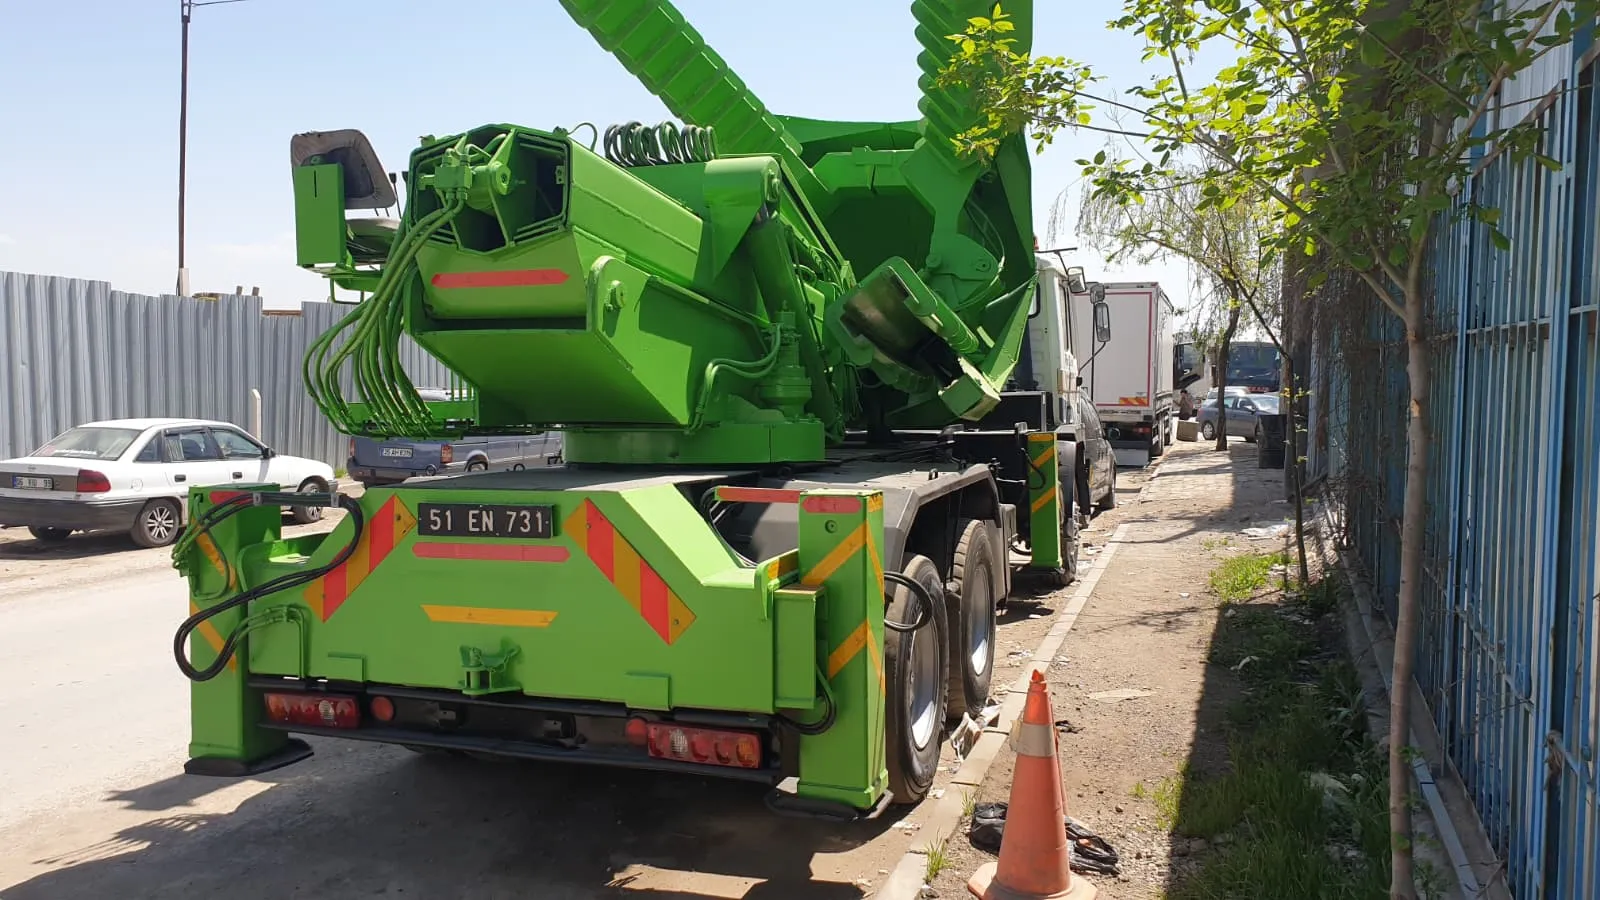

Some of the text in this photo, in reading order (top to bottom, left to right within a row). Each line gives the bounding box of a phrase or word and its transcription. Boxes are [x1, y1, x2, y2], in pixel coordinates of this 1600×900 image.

[430, 509, 543, 533] 51 EN 731
